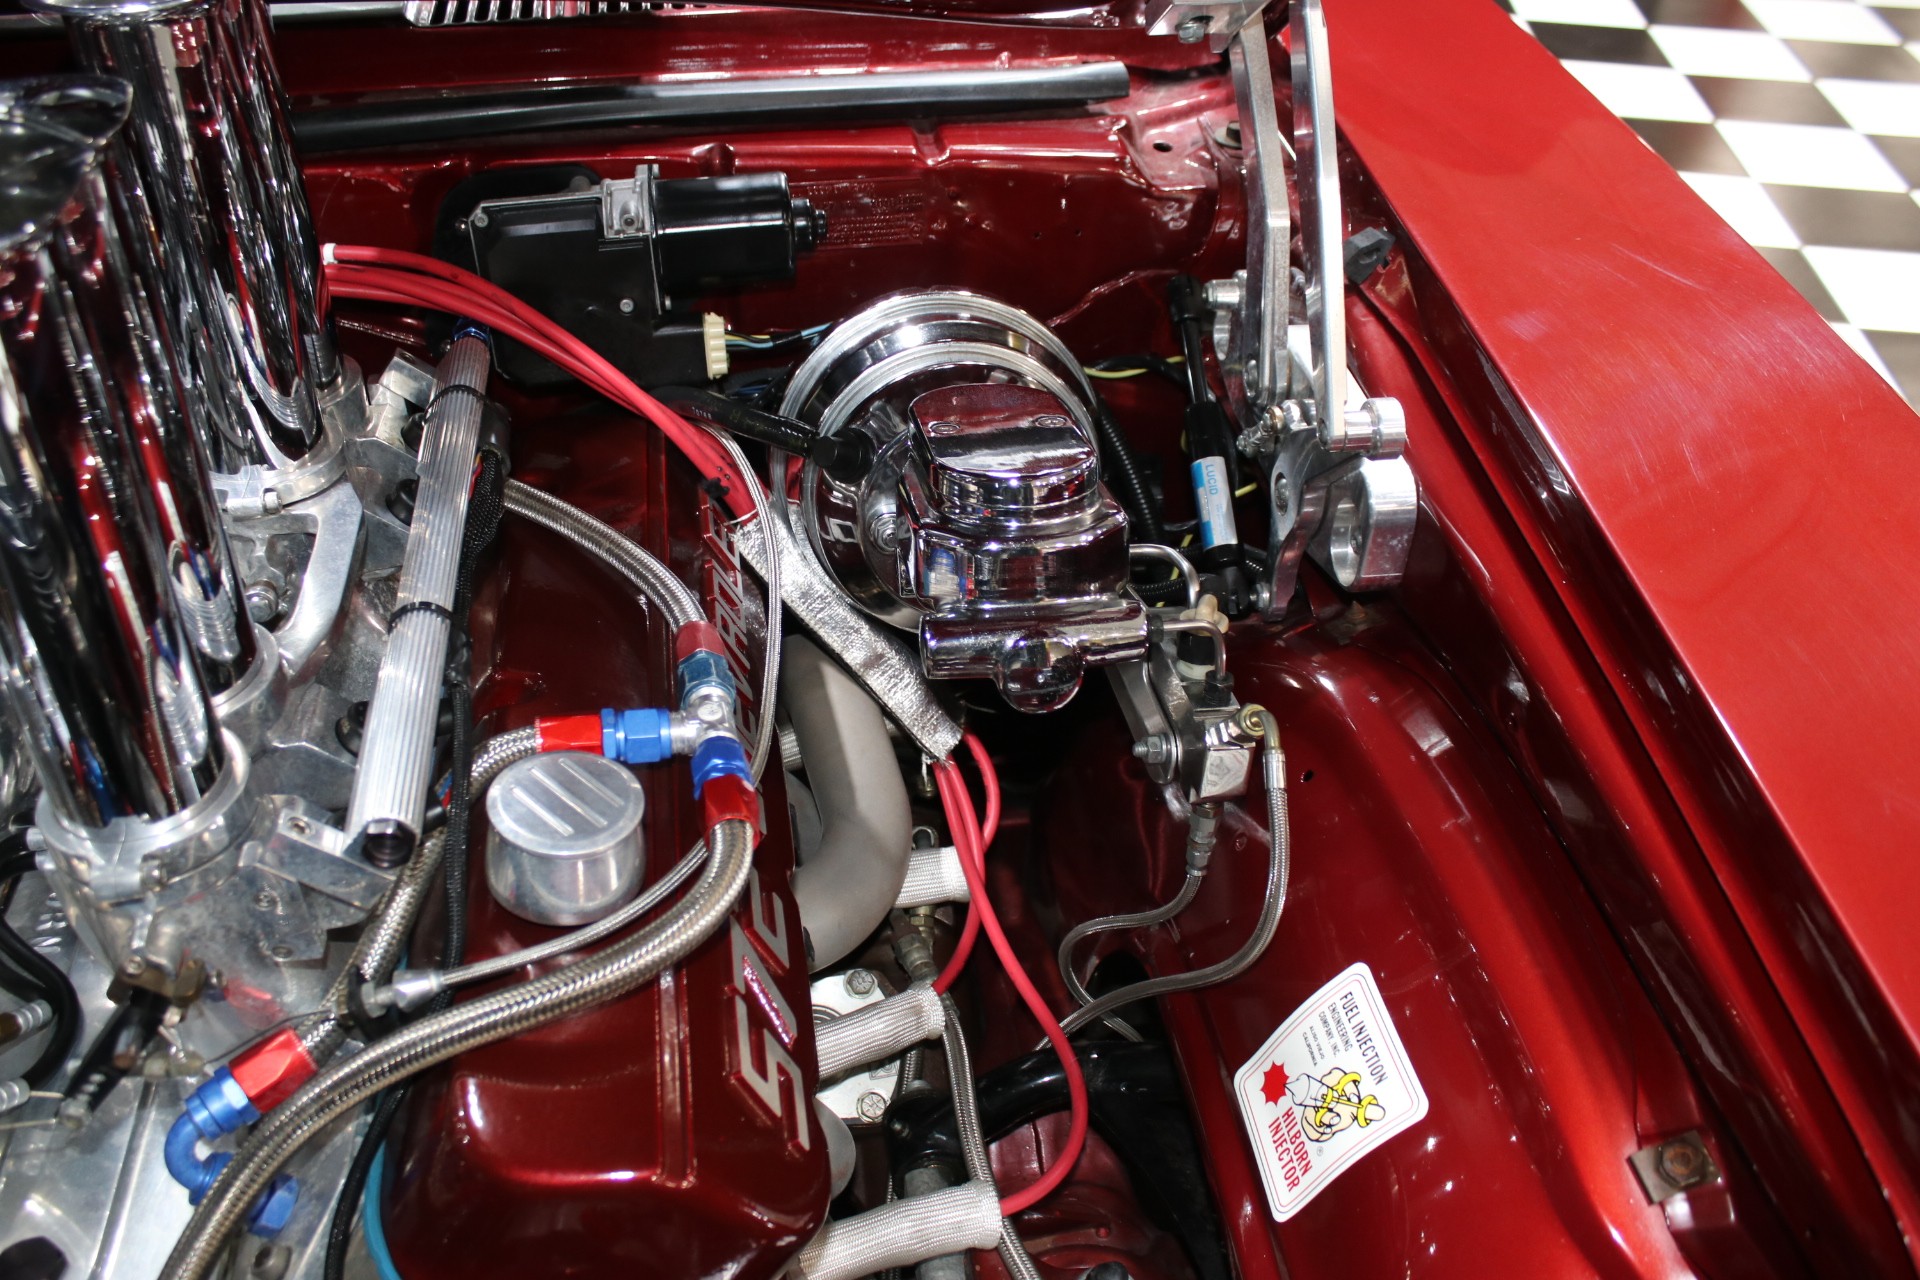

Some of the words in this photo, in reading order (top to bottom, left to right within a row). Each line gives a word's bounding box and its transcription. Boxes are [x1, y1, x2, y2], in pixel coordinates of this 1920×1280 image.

[1205, 464, 1219, 496] LUCID
[708, 494, 768, 836] EVROLE
[1302, 1031, 1318, 1067] CALIFORNIA
[1327, 1001, 1353, 1052] ENGINEERING
[1330, 1041, 1341, 1058] INC.
[1339, 991, 1360, 1024] FUEL
[1352, 1020, 1389, 1086] INJECTION
[1268, 1116, 1301, 1193] INJECTOR
[1281, 1106, 1313, 1177] HILBORN
